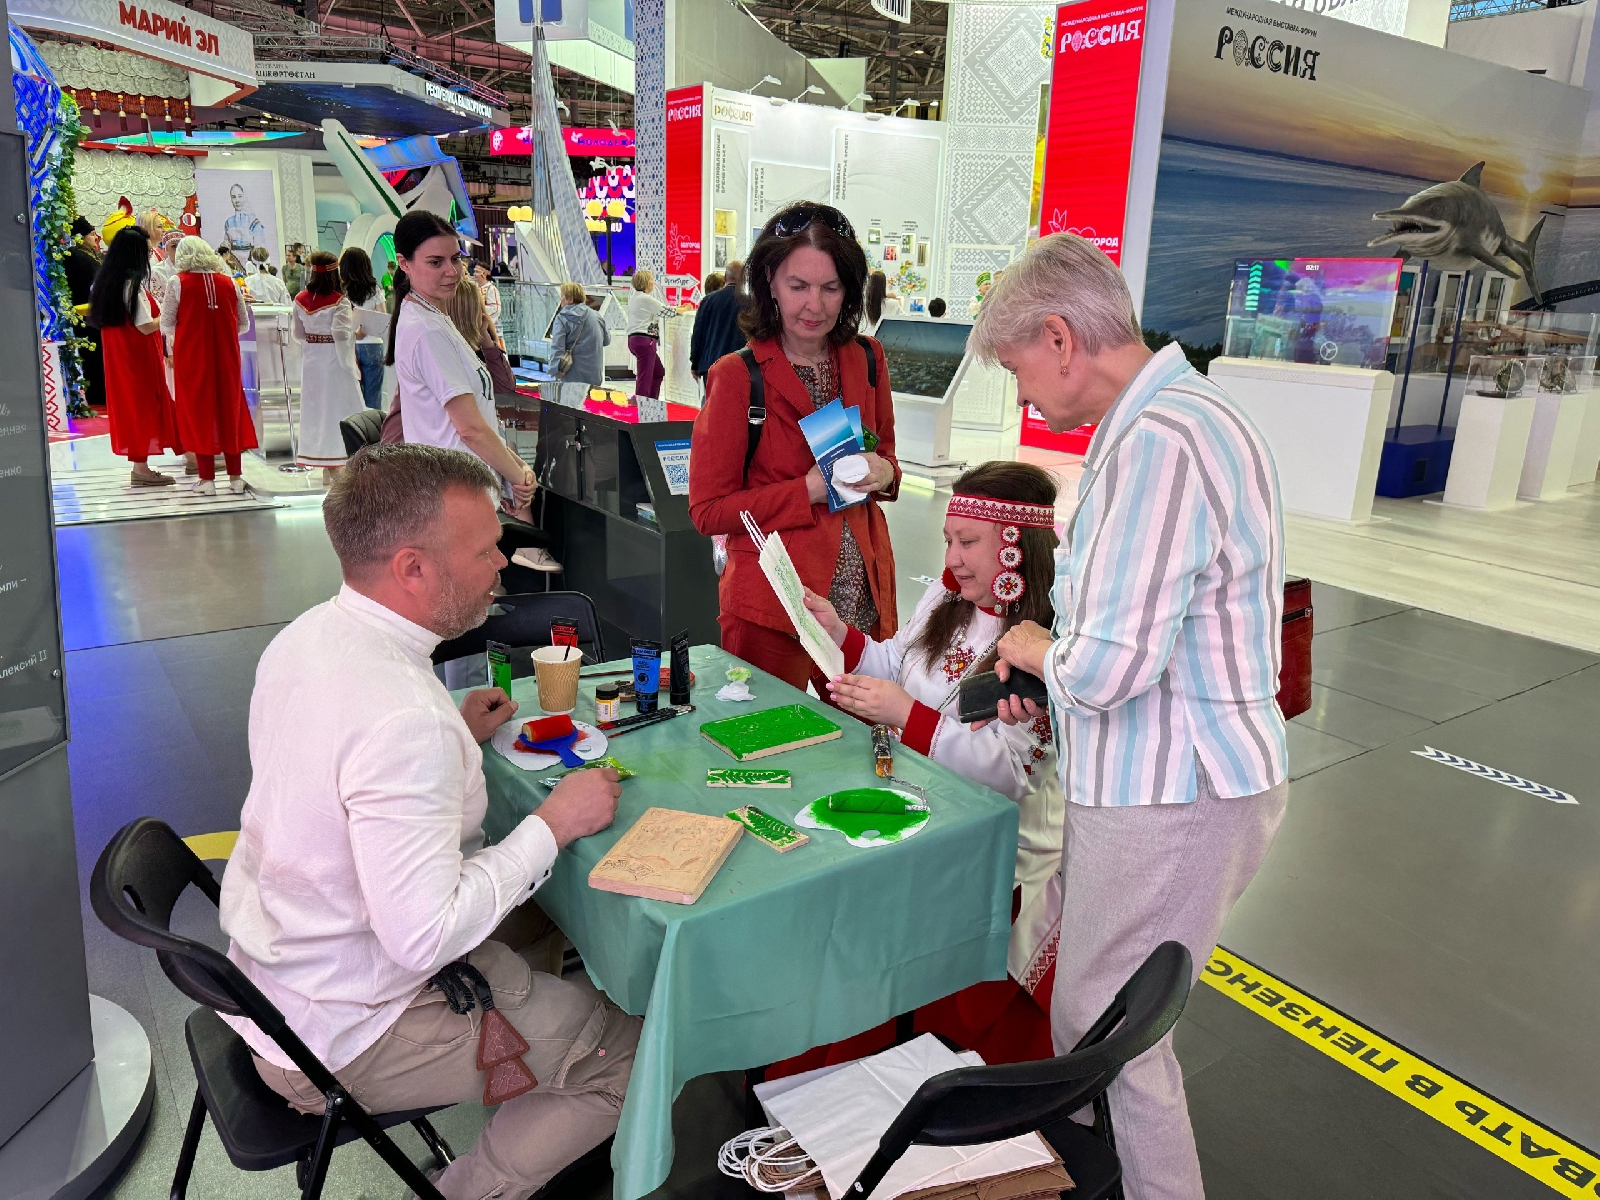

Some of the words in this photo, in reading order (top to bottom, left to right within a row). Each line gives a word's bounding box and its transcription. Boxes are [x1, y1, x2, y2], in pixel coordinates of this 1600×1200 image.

[118, 1, 191, 47] МАРИЙ
[195, 29, 219, 56] ЭЛ
[1059, 19, 1142, 54] РОССИЯ
[1226, 6, 1273, 26] МЕЖДУНАРОДНАЯ
[1272, 19, 1318, 38] ВЫСТАВКА-ФОРУМ
[1214, 25, 1320, 81] РОССИЯ
[667, 104, 702, 122] РОССИЯ
[714, 105, 753, 121] РОССИЯ
[0, 654, 37, 679] лексий
[1204, 957, 1400, 1074] ПЕНЗЕНС
[1404, 1073, 1444, 1100] В
[1455, 1101, 1600, 1198] ВАТЬ
